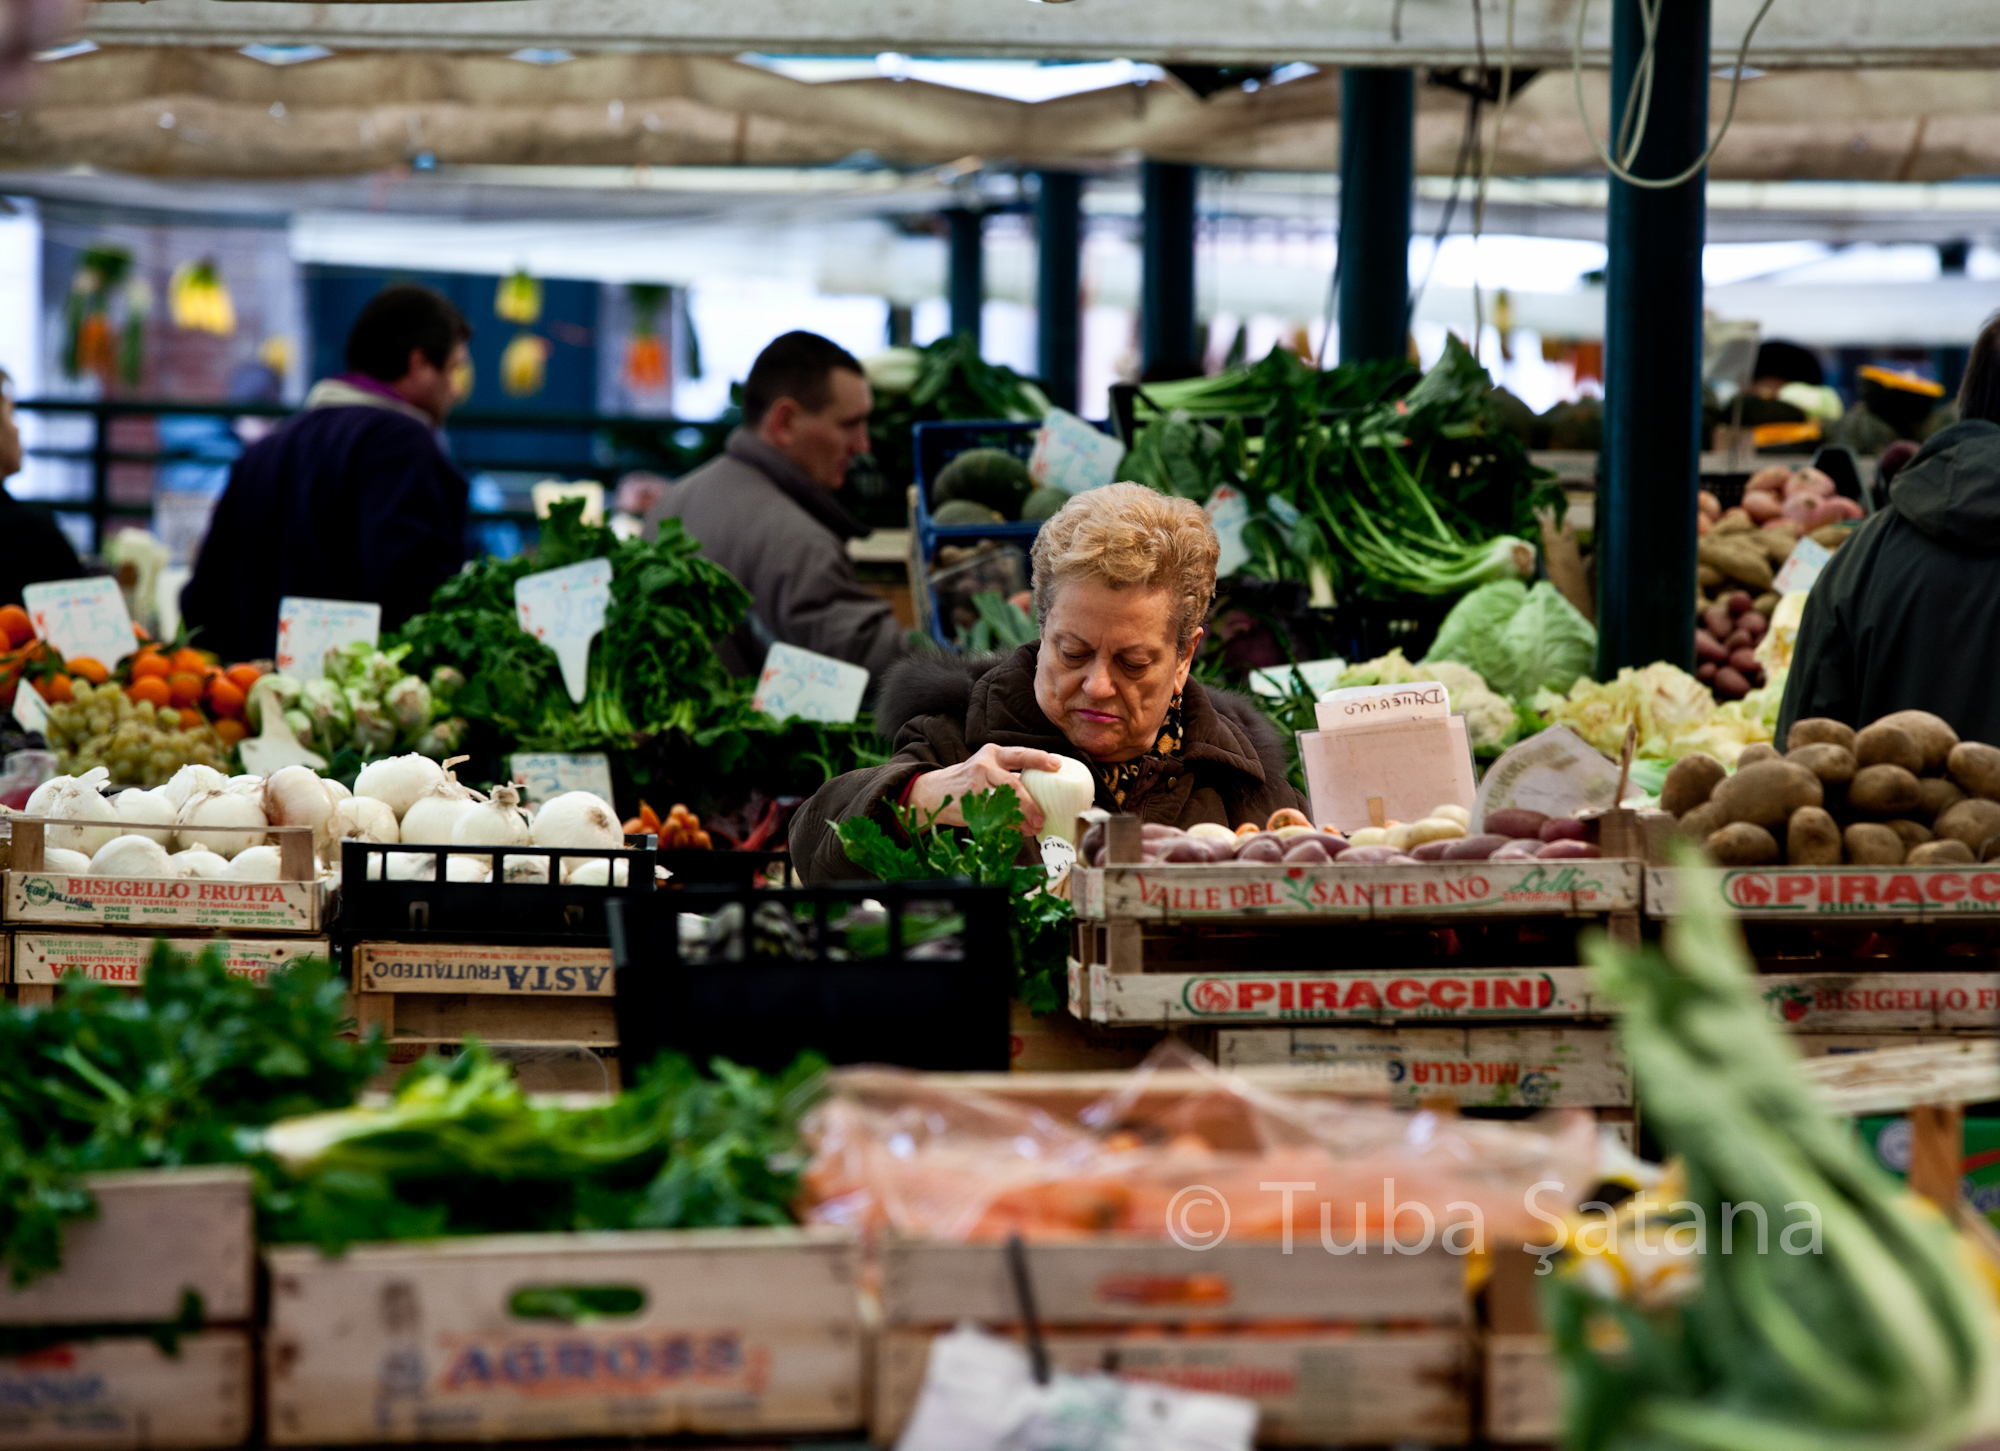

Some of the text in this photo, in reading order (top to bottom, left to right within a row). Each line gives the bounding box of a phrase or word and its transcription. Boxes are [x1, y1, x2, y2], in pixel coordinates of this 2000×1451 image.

[67, 878, 287, 903] BISIGELLO FRUTTA
[1134, 873, 1221, 910] VALLE
[1229, 882, 1282, 908] DEL
[1311, 876, 1490, 906] SANTERNO
[373, 962, 610, 991] ASTA FRUTTALTEDO
[1237, 979, 1552, 1010] PIRACCINI
[1815, 987, 1969, 1011] BISIGELLO
[1412, 1062, 1519, 1085] MILELLA
